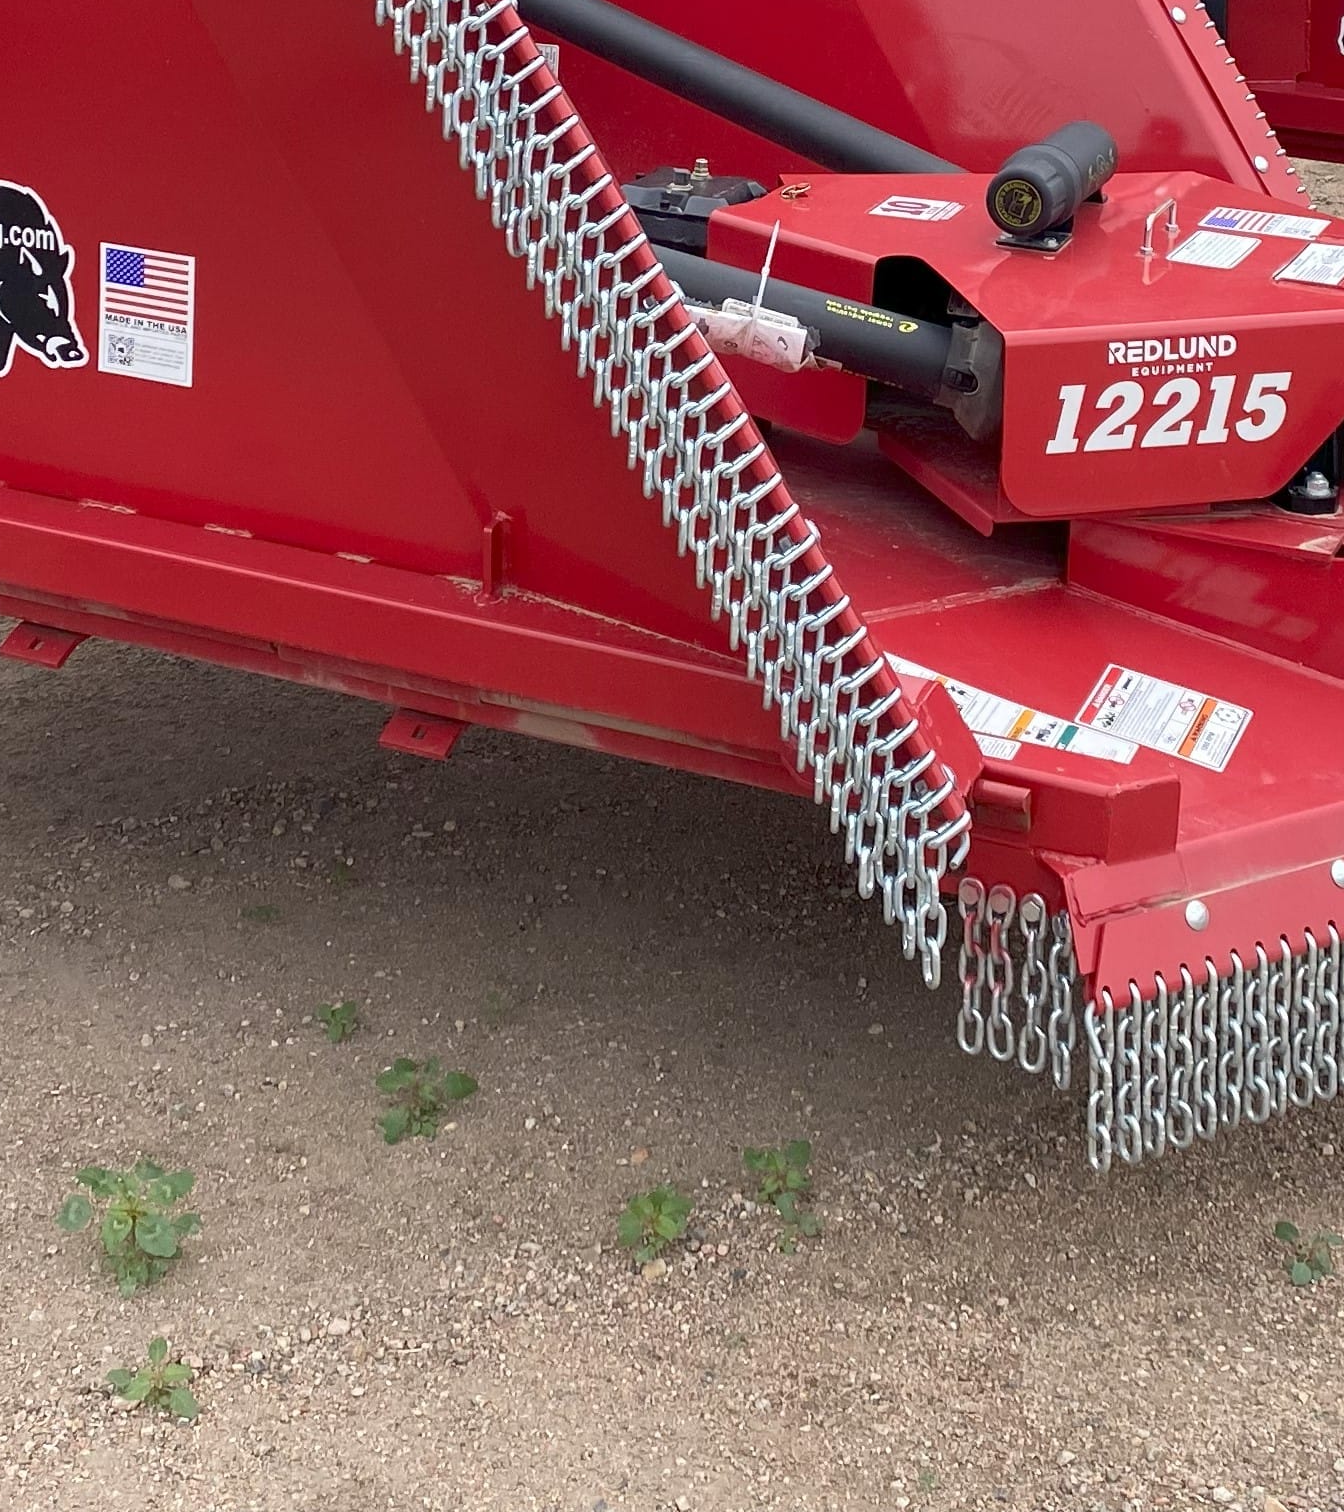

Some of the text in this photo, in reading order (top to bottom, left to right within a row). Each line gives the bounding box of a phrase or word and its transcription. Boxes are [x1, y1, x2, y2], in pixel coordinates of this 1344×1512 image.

[104, 313, 131, 325] MADE
[134, 319, 144, 327] IN
[147, 321, 165, 330] THE
[168, 325, 187, 334] USA
[1107, 334, 1238, 365] REDLUND
[1131, 361, 1214, 377] EQUIPMENT
[1045, 371, 1293, 456] 12215
